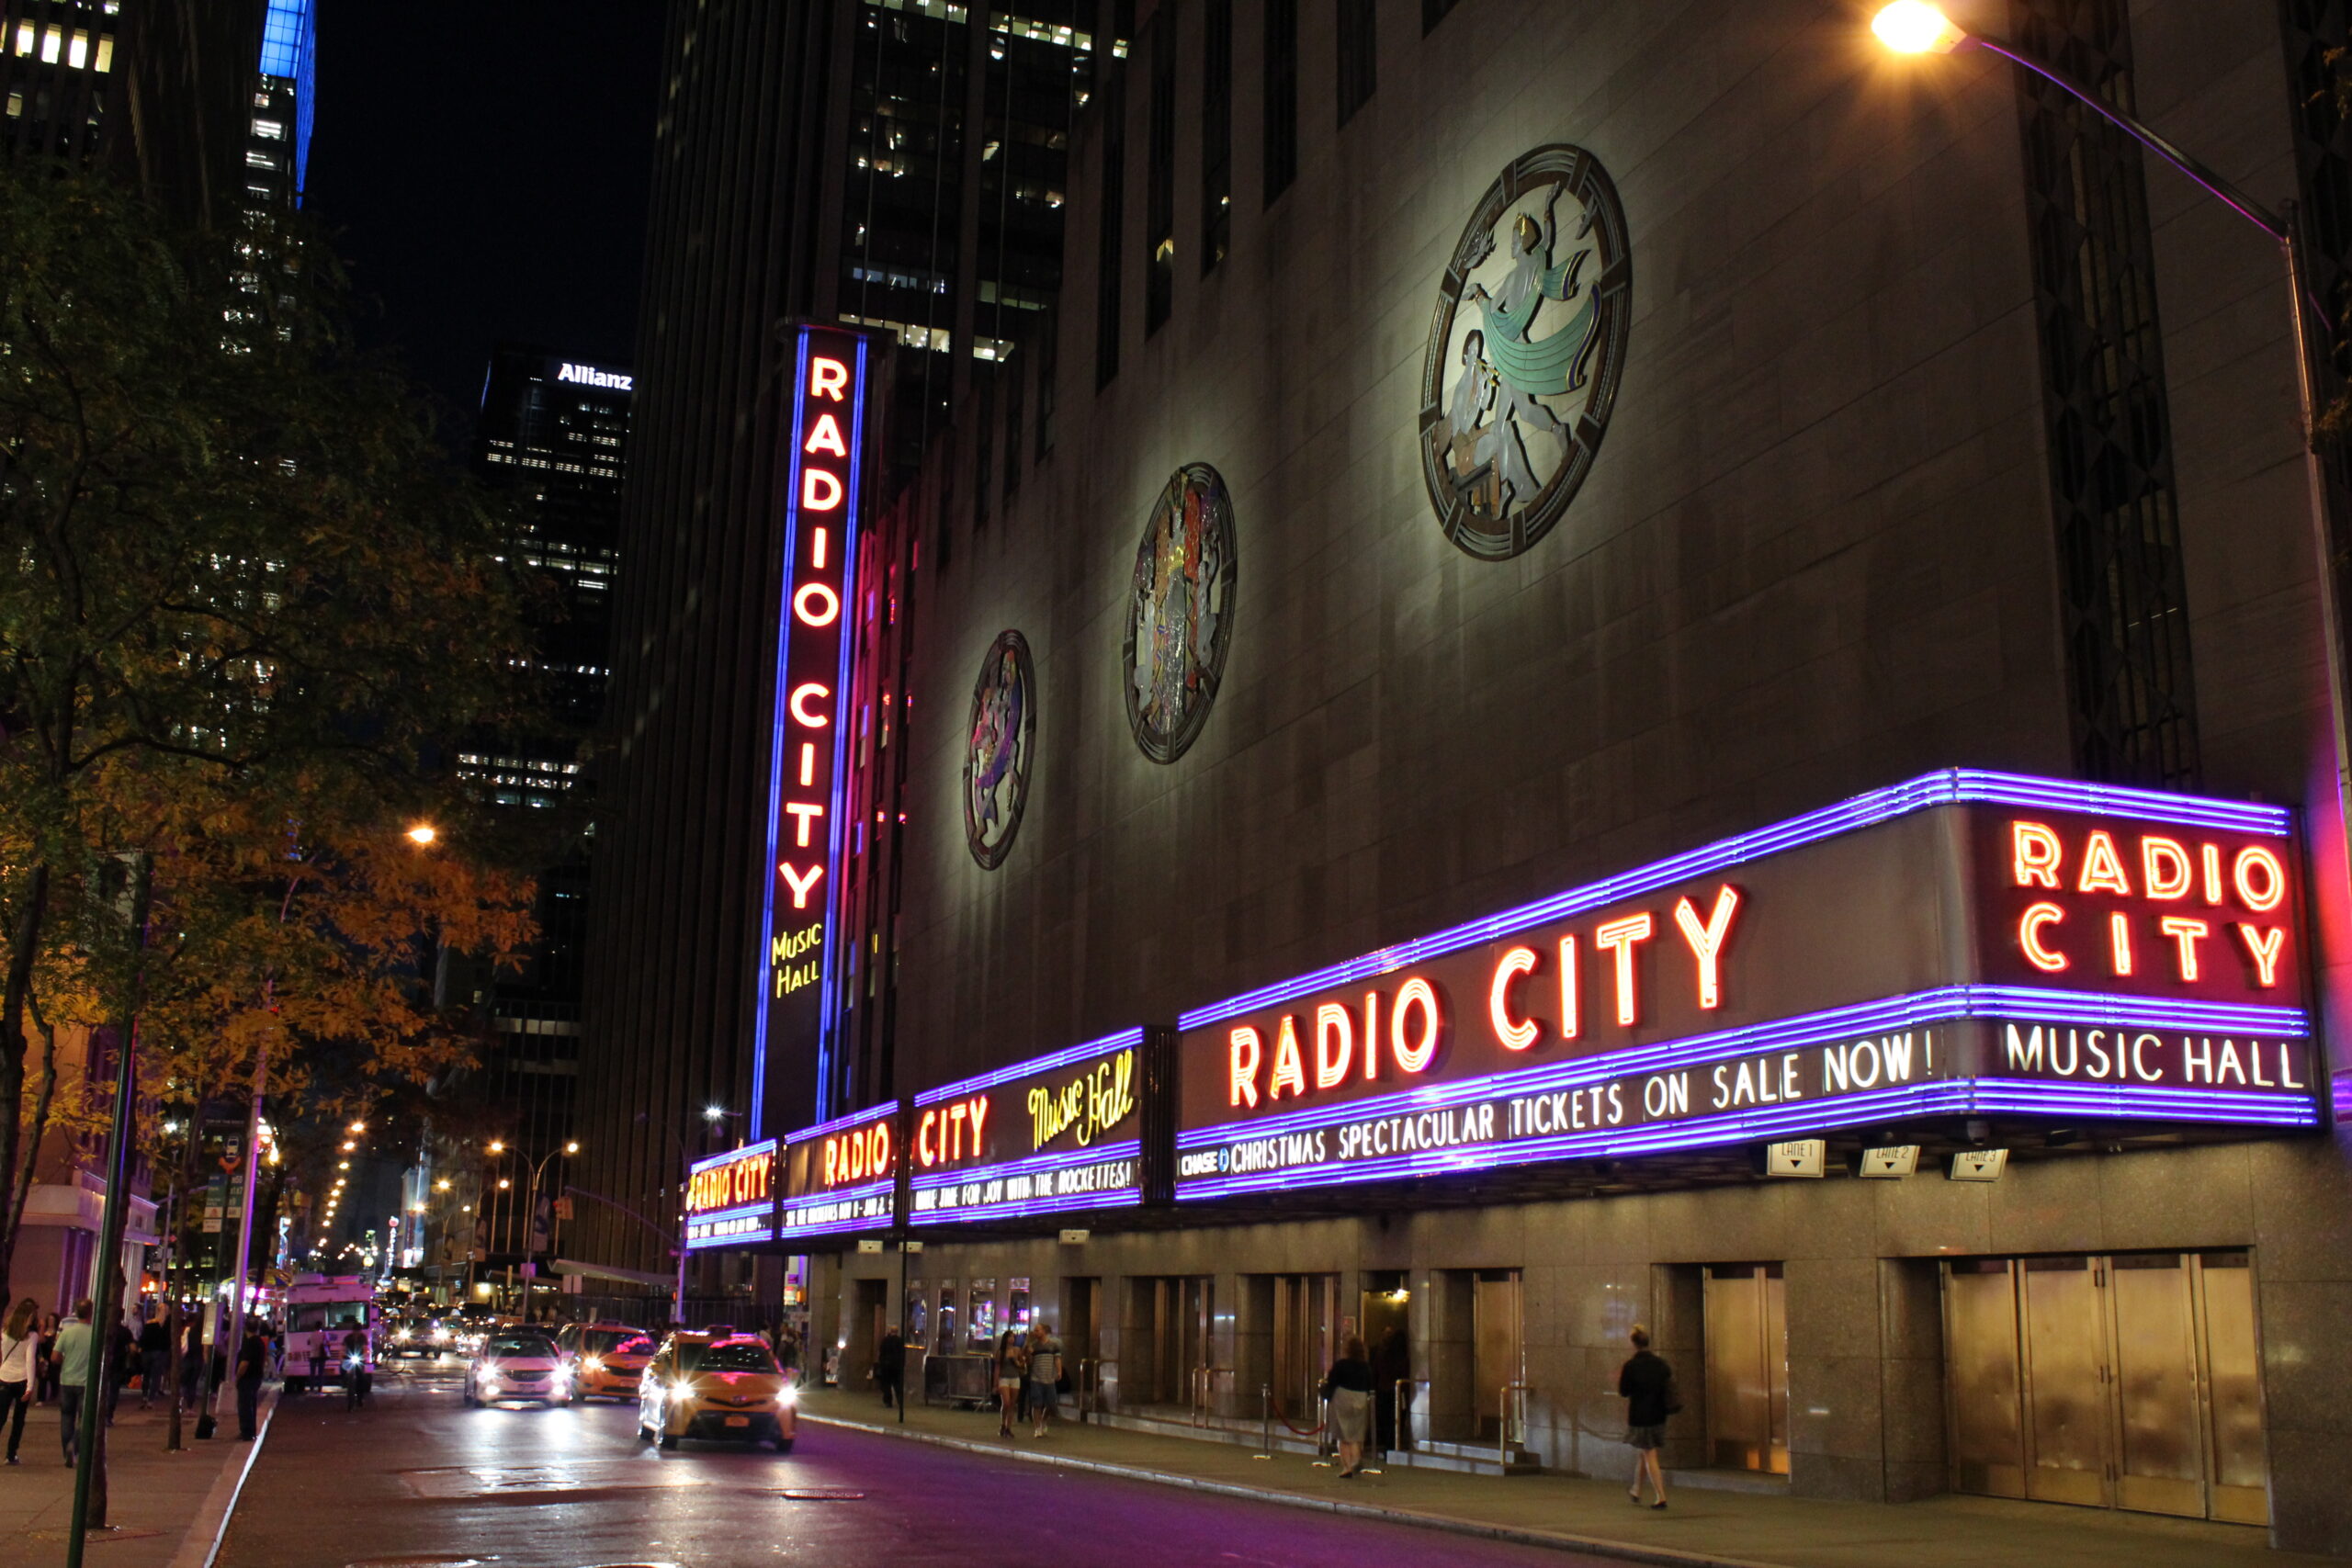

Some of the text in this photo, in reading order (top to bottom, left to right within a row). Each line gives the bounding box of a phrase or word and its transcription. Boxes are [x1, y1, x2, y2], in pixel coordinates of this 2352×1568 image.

[558, 363, 632, 390] Allianz
[793, 355, 849, 627] RADIO
[779, 682, 830, 909] CITY
[2012, 820, 2285, 911] RADIO
[772, 923, 822, 966] MUSIC
[2020, 901, 2286, 987] CITY
[776, 960, 820, 999] HALL
[1229, 883, 1740, 1110] RADIO CITY
[2007, 1023, 2304, 1089] MUSIC HALL
[919, 1048, 1134, 1168] CITY Music Hall
[1181, 1151, 1218, 1177] CHASE
[1230, 1131, 1326, 1174] CHRISTMAS
[1338, 1103, 1494, 1160] SPECTACULAR
[1511, 1082, 1623, 1136] TICKETS
[1644, 1072, 1689, 1118] ON
[1713, 1054, 1801, 1110] SALE
[824, 1122, 889, 1187] RADIO
[1781, 1142, 1806, 1156] LANE
[1876, 1146, 1908, 1159] LANE 2
[694, 1156, 770, 1212] RADIO CITY
[962, 1184, 980, 1205] FOR
[983, 1179, 1002, 1204] JOY
[1035, 1172, 1053, 1197] THE
[1058, 1161, 1131, 1194] ROCKETTES!
